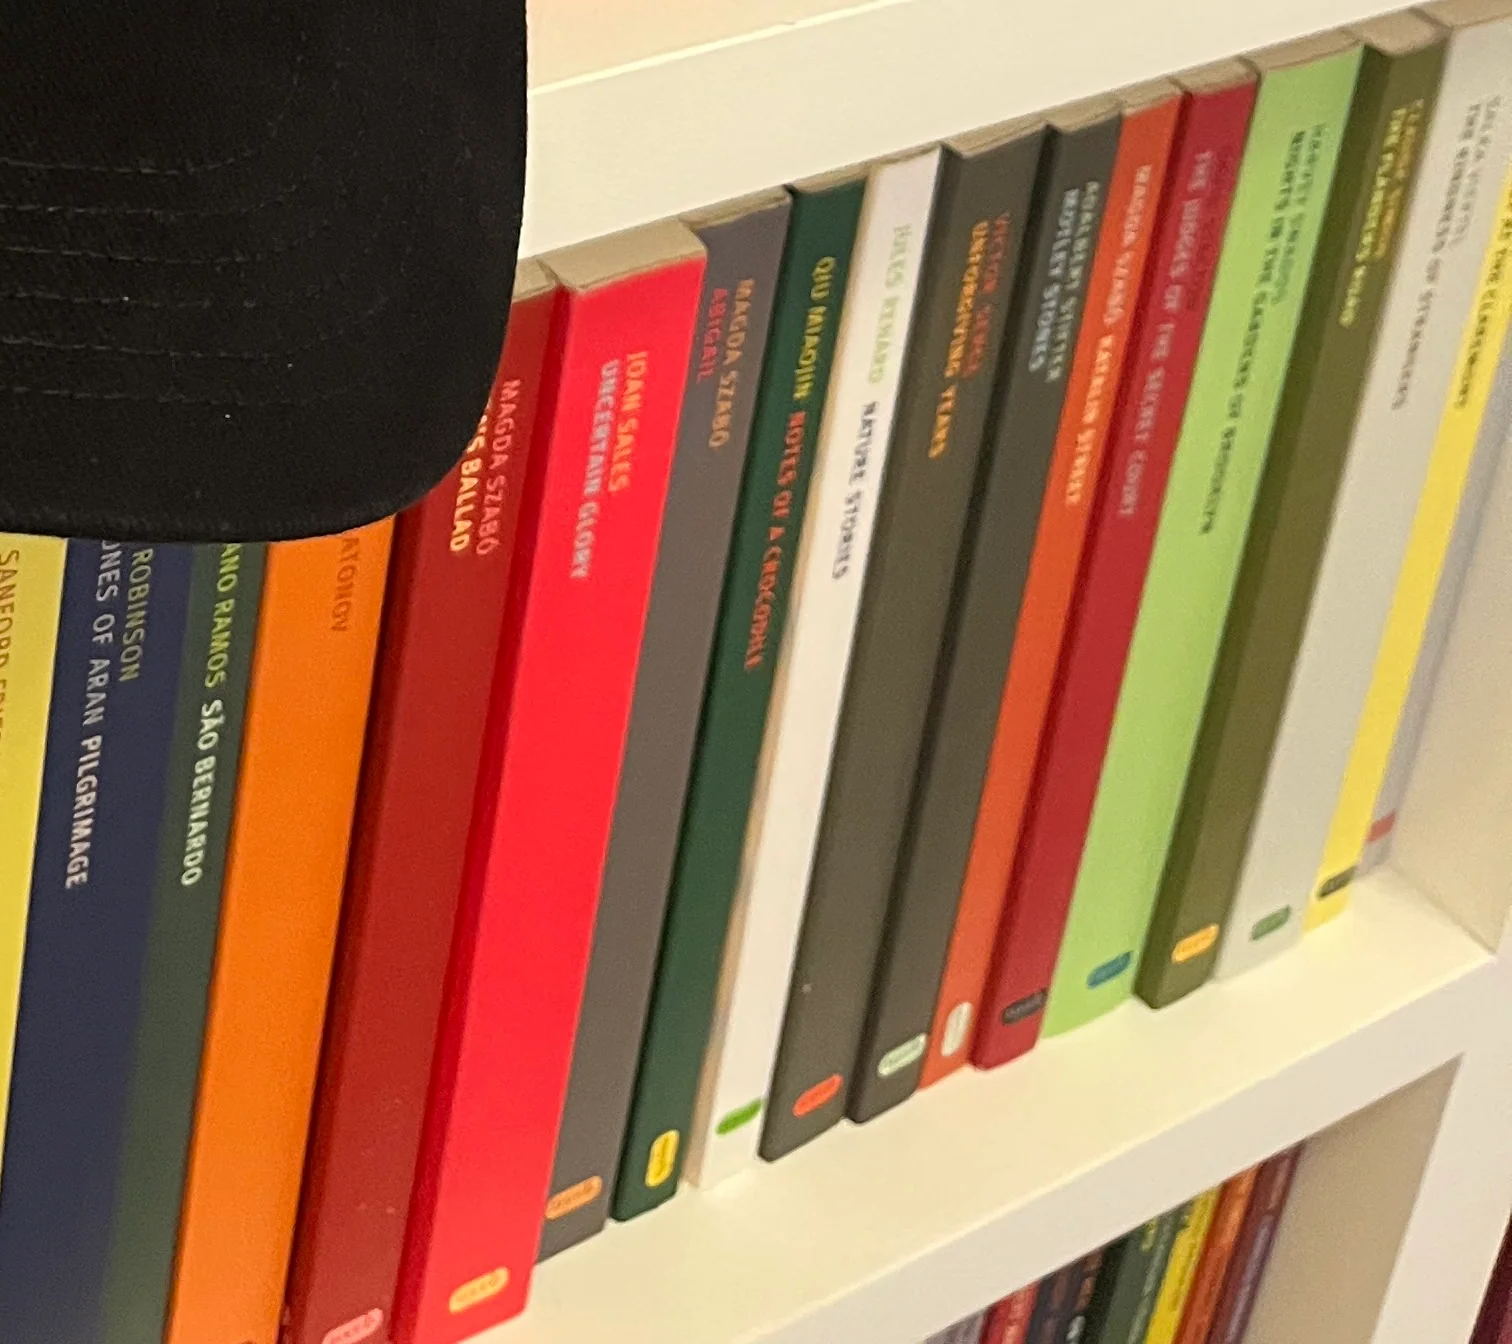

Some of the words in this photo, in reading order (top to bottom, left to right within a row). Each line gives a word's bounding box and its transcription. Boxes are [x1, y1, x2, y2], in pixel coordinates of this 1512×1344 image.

[488, 378, 520, 470] MAGDA
[606, 416, 639, 492] SALES
[449, 457, 481, 551] BALLAD
[91, 608, 114, 644] OF
[119, 548, 153, 681] ROBINSON
[331, 536, 359, 632] ATONOV
[205, 597, 232, 687] RAMOS
[82, 656, 111, 725] ARAN
[195, 699, 223, 750] SÃO
[64, 734, 101, 888] PILGRIMAGE
[181, 757, 213, 885] BERNARDO
